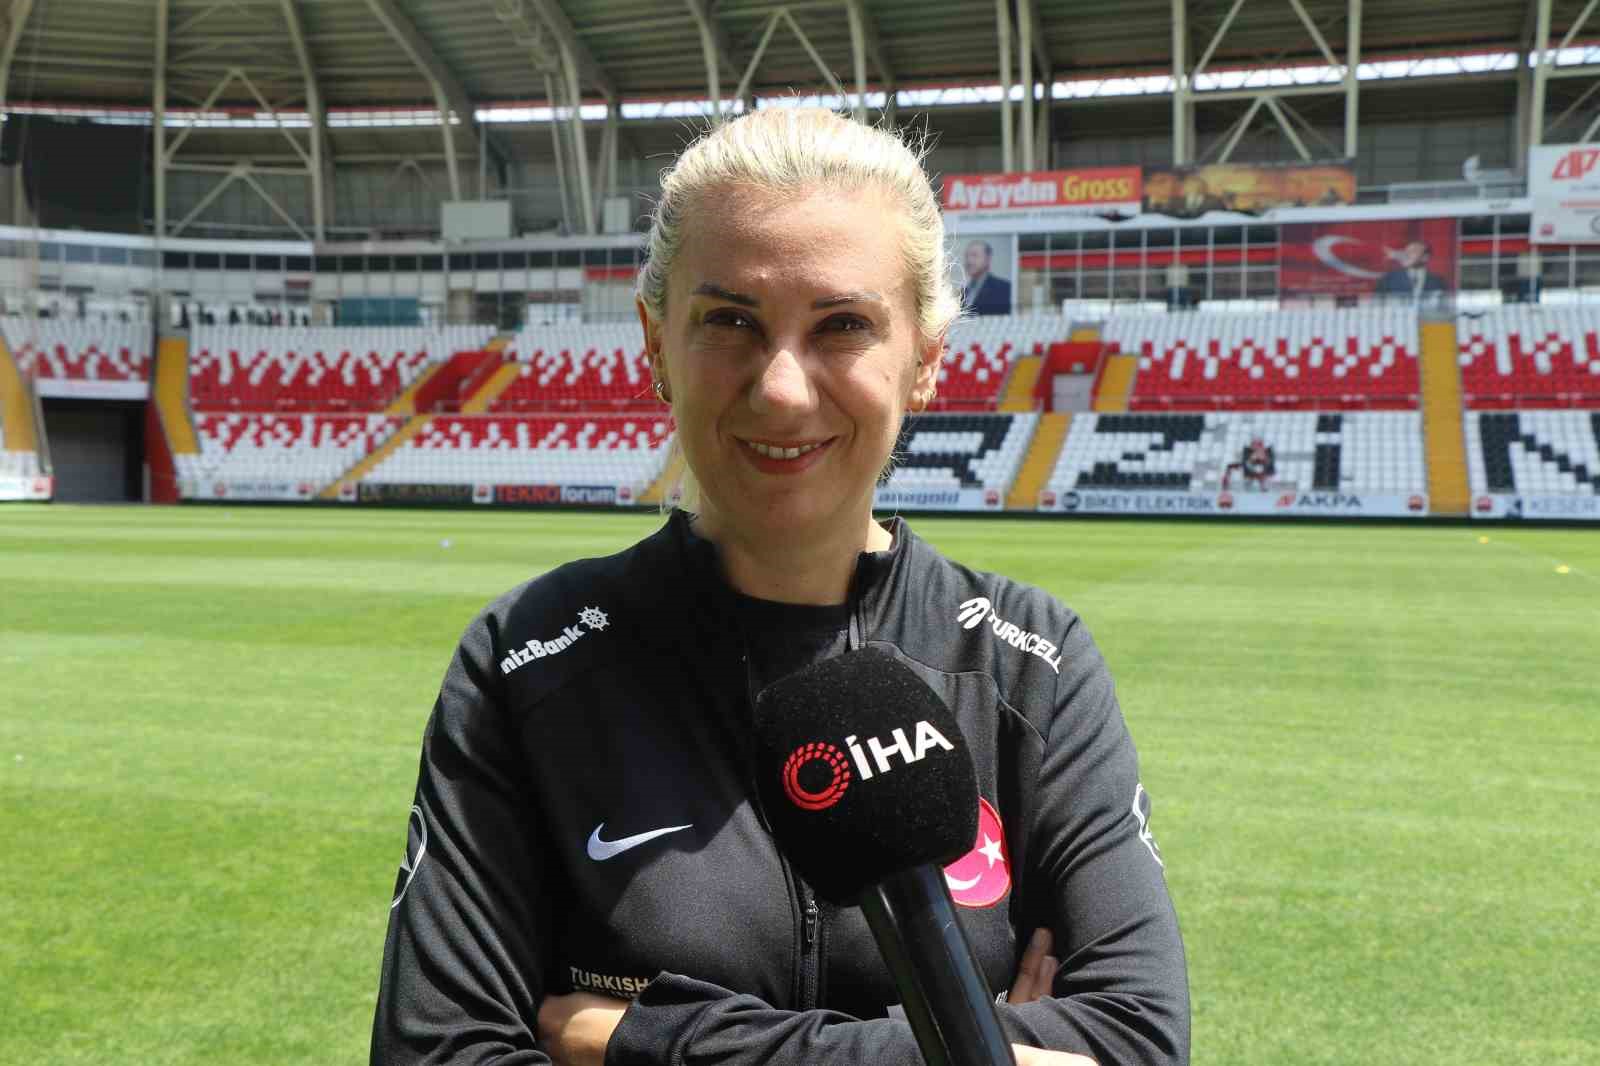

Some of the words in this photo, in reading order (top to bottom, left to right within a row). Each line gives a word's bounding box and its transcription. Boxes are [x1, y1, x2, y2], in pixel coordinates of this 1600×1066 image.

[947, 176, 1058, 209] Ayaydın
[1063, 175, 1129, 200] Gross
[1298, 494, 1362, 509] AKPA
[500, 624, 586, 674] nizBank
[987, 607, 1062, 674] TURKCELL
[845, 720, 955, 781] İHA
[569, 966, 648, 993] TURKISH
